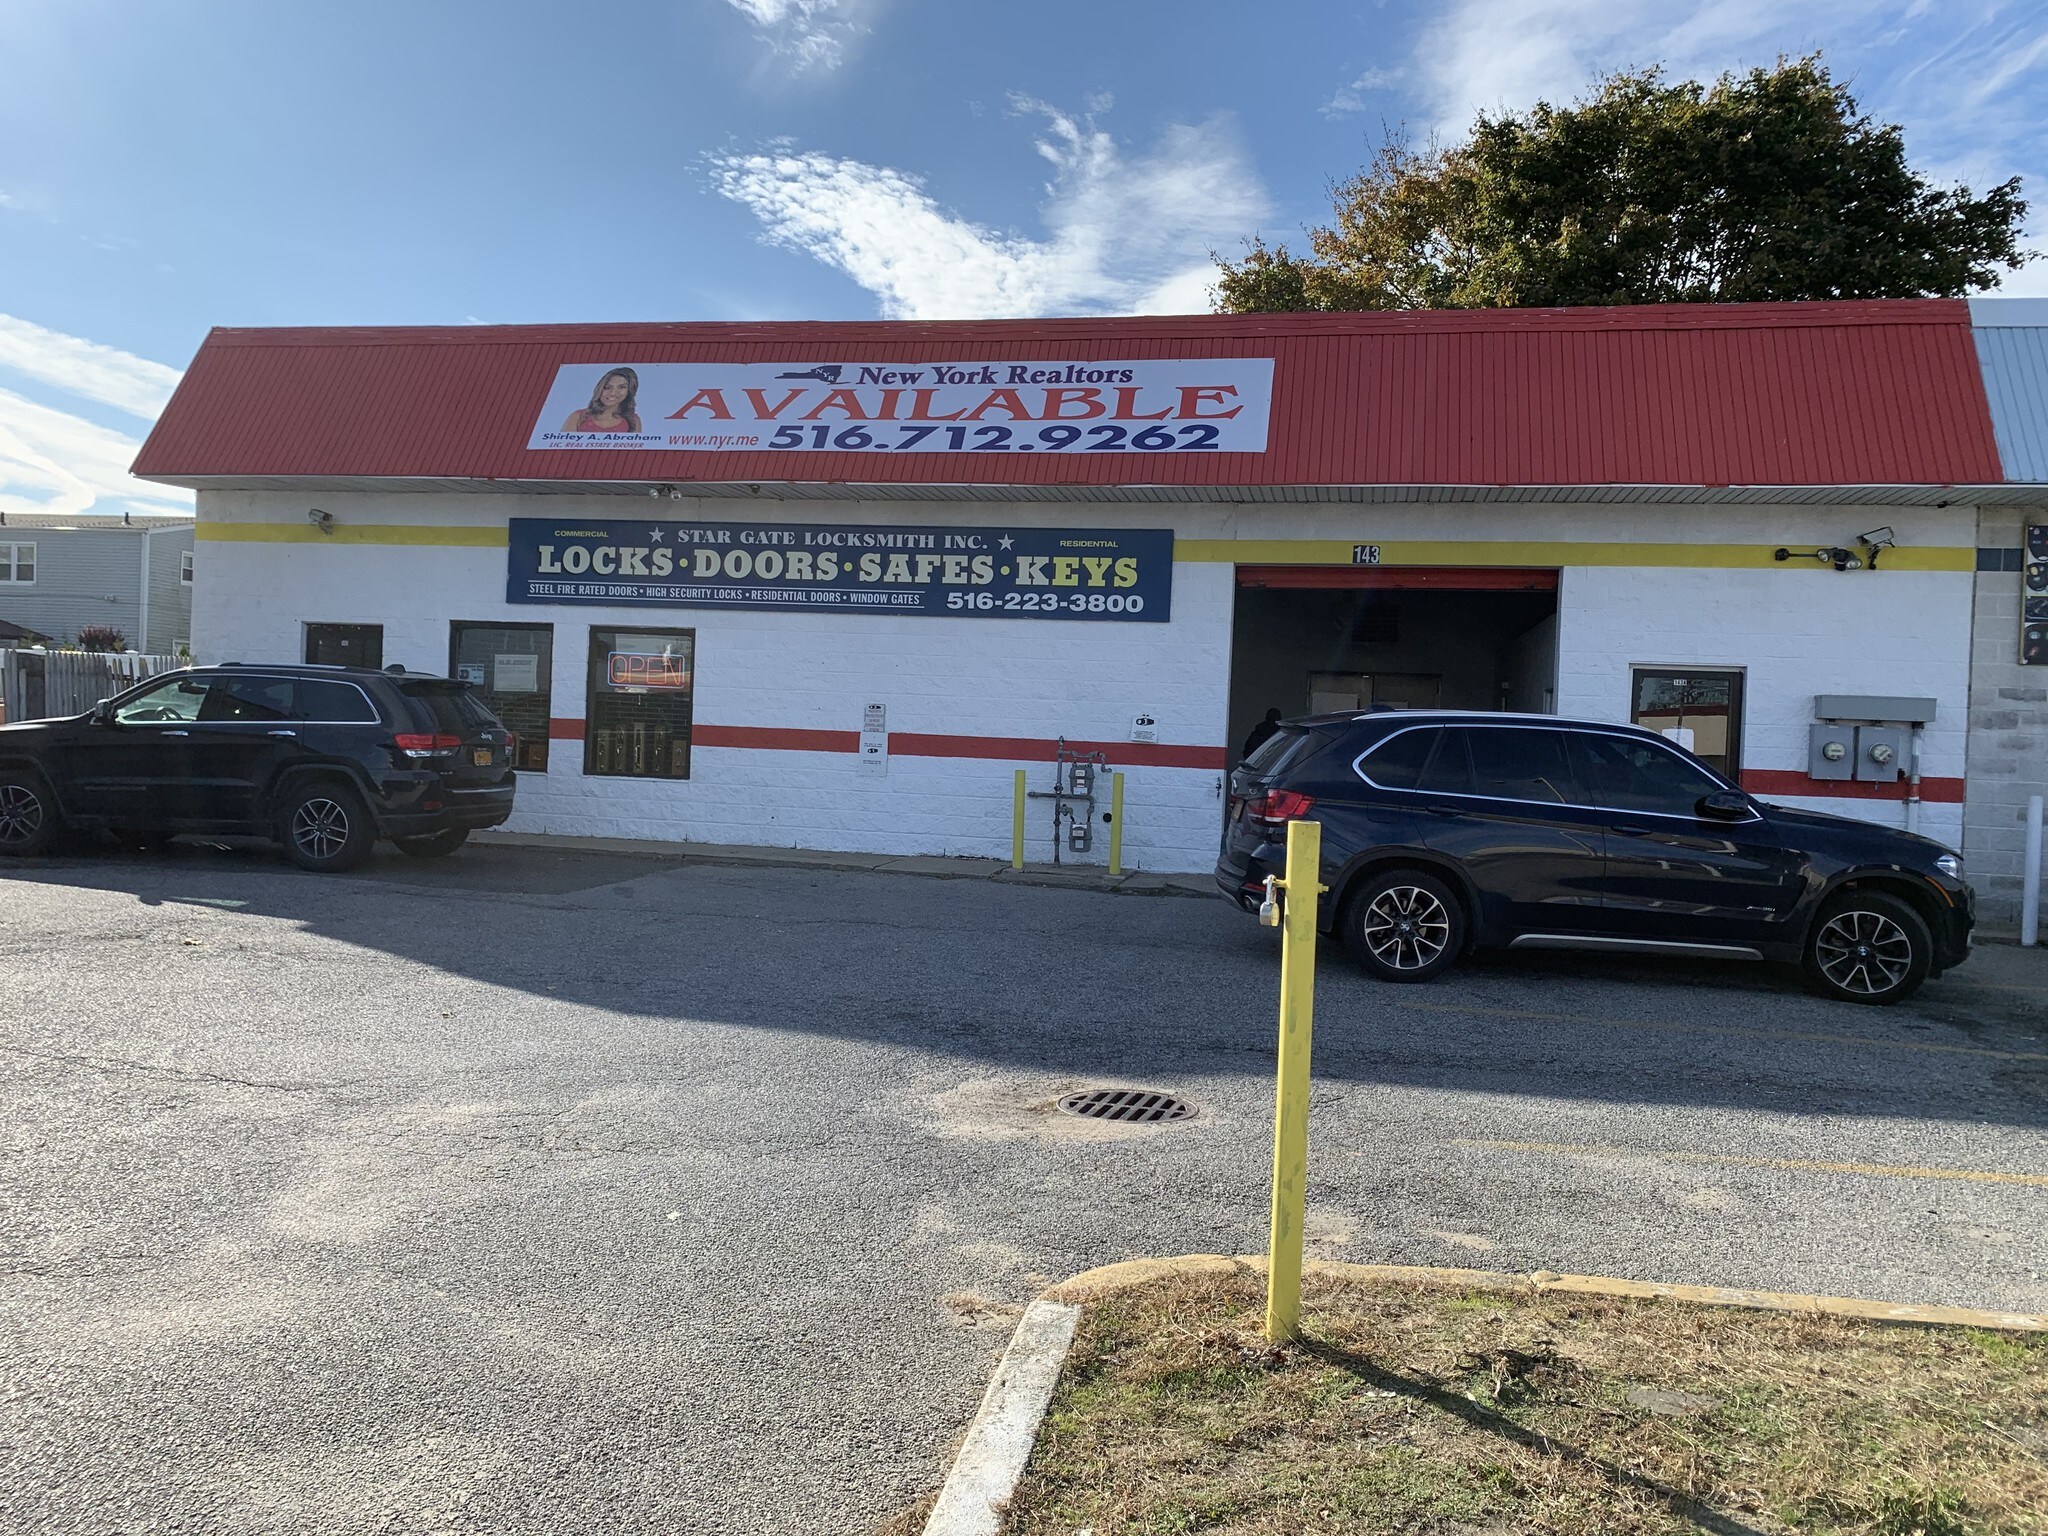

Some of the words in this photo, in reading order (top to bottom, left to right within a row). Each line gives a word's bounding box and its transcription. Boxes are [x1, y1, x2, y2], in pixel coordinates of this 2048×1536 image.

[855, 366, 924, 386] New
[932, 365, 999, 386] York
[1004, 364, 1133, 385] Realtors
[664, 385, 1245, 421] AVAILABLE
[542, 433, 584, 442] Shirley
[587, 433, 600, 441] A.
[603, 433, 661, 442] Abraham
[668, 433, 759, 447] www.nyr.me
[768, 424, 1220, 450] 516.712.9262
[554, 530, 609, 538] COMMERCIAL
[678, 529, 732, 544] STAR
[740, 530, 796, 546] GATE
[804, 531, 935, 548] LOCKSMITH
[944, 534, 988, 549] INC.
[1060, 540, 1118, 548] RESIDENTIAL
[1354, 546, 1380, 563] 143
[538, 545, 673, 577] LOCKS
[693, 549, 839, 581] DOORS
[858, 553, 993, 585] SAFES
[1015, 555, 1138, 588] KEYS
[529, 583, 555, 594] STEEL
[557, 584, 576, 595] FIRE
[578, 584, 606, 596] RATED
[608, 585, 638, 596] DOORS
[646, 586, 667, 597] HIGH
[669, 586, 711, 599] SECURITY
[714, 588, 742, 600] LOCKS
[751, 589, 808, 602] RESIDENTIAL
[810, 591, 841, 602] DOORS
[850, 592, 888, 604] WINDOW
[891, 593, 920, 605] GATES
[946, 592, 1144, 613] 516-223-3800
[610, 655, 682, 686] OPEN
